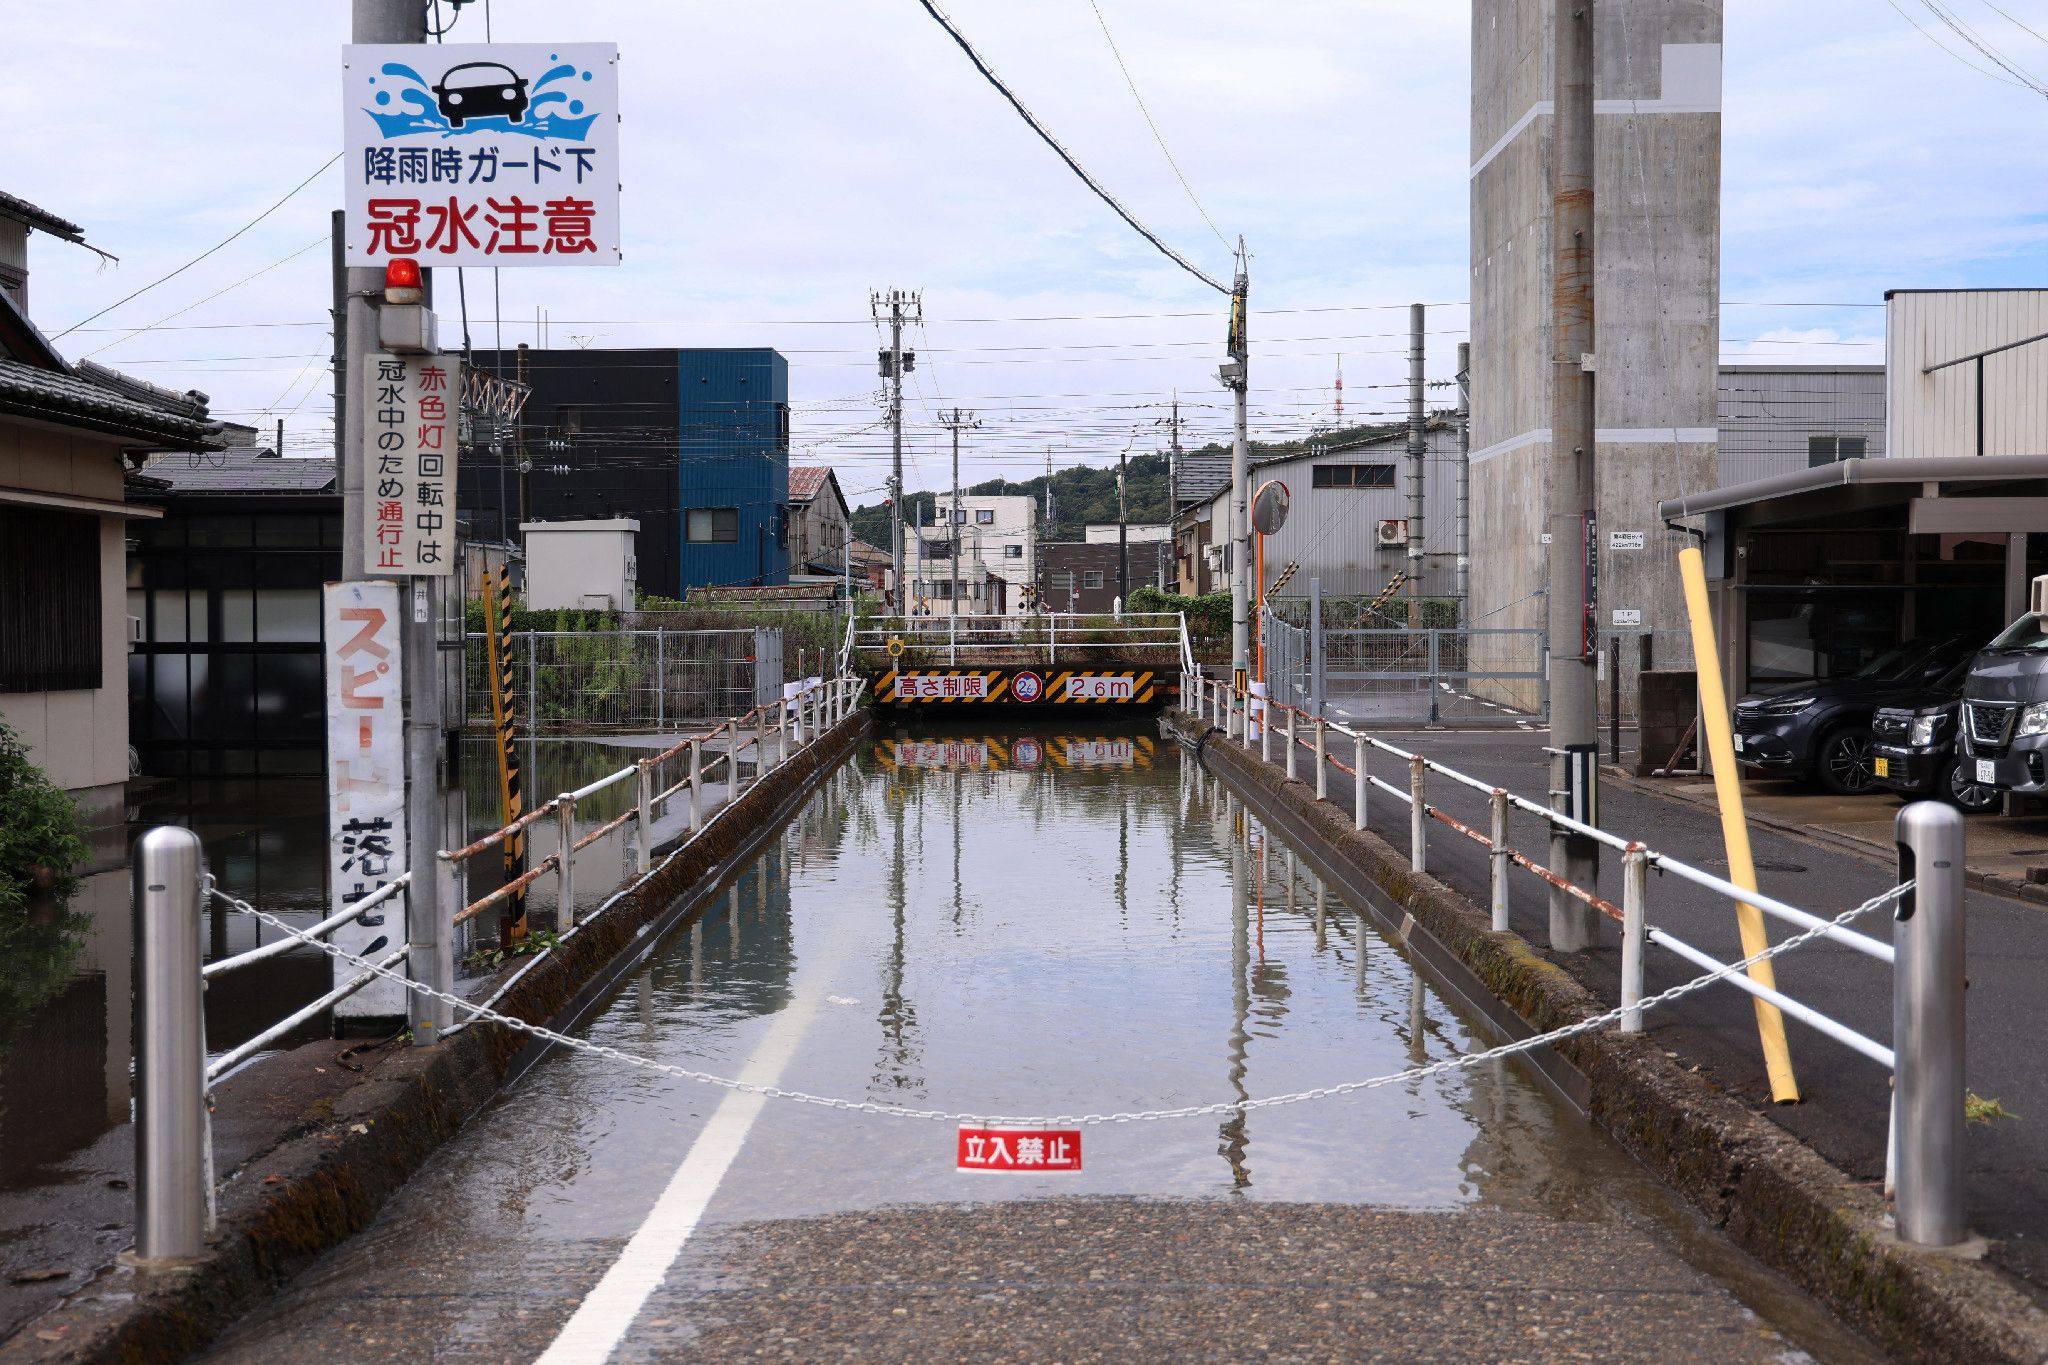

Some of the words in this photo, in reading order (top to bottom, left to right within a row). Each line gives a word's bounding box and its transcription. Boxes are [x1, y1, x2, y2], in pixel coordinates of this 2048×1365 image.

[365, 146, 596, 185] 降雨時ガード下
[366, 196, 597, 255] 冠水注意
[376, 360, 406, 568] 冠水中のため通行止
[416, 365, 447, 563] 赤色灯回転中は
[900, 677, 982, 697] 高さ制限
[1072, 679, 1129, 697] 2.6m
[965, 1135, 1072, 1164] 立入禁止
